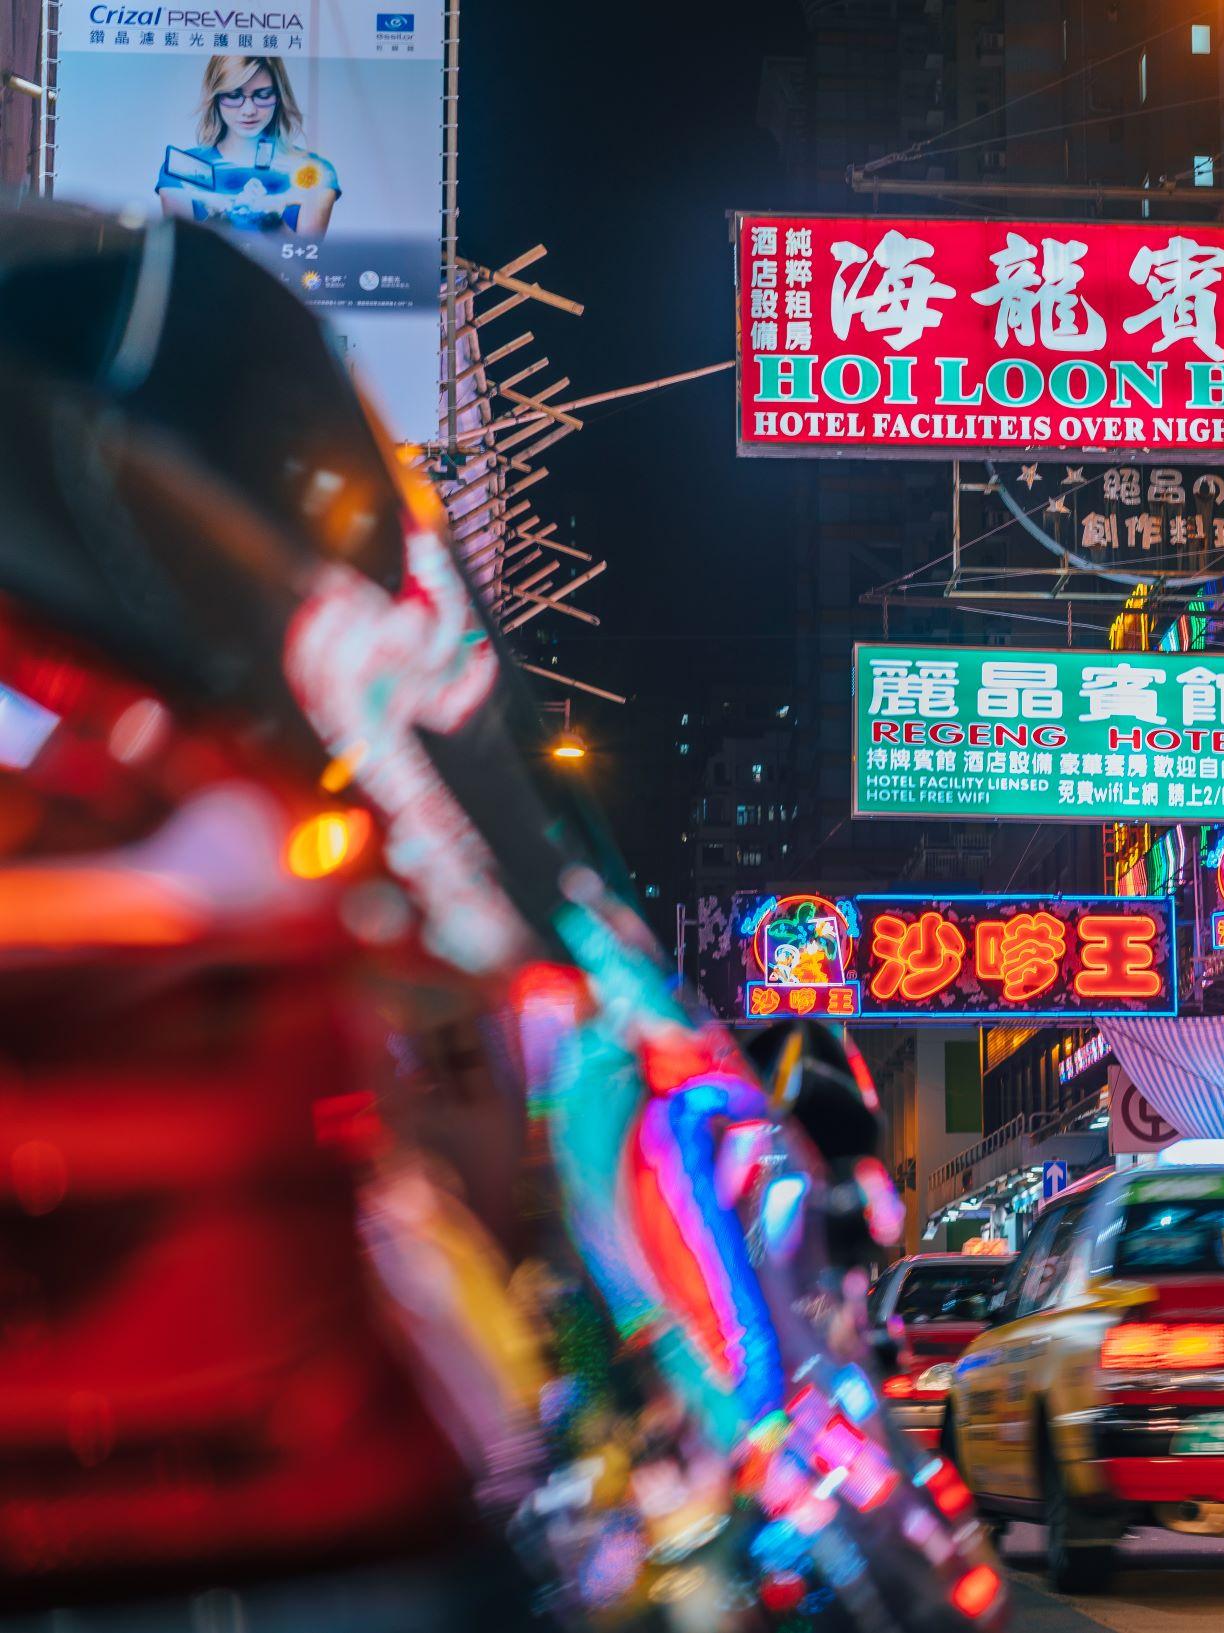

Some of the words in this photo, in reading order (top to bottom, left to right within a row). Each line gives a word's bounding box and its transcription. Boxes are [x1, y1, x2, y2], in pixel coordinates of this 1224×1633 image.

[90, 4, 162, 26] Crizal
[168, 10, 304, 29] PREVENCIA
[281, 244, 319, 259] 5+2
[750, 226, 779, 351] 酒店設備
[785, 227, 813, 351] 純粹租房
[753, 354, 918, 405] HOI
[935, 356, 1168, 409] LOON
[753, 411, 865, 437] HOTEL
[872, 413, 1051, 440] FACILITEIS
[871, 721, 1068, 749] REGENG
[866, 747, 955, 773] 持牌賓館
[866, 775, 915, 788] HOTEL
[919, 776, 984, 790] FACILITY
[866, 789, 915, 802] HOTEL
[919, 790, 953, 803] FREE
[957, 791, 990, 804] WIFI
